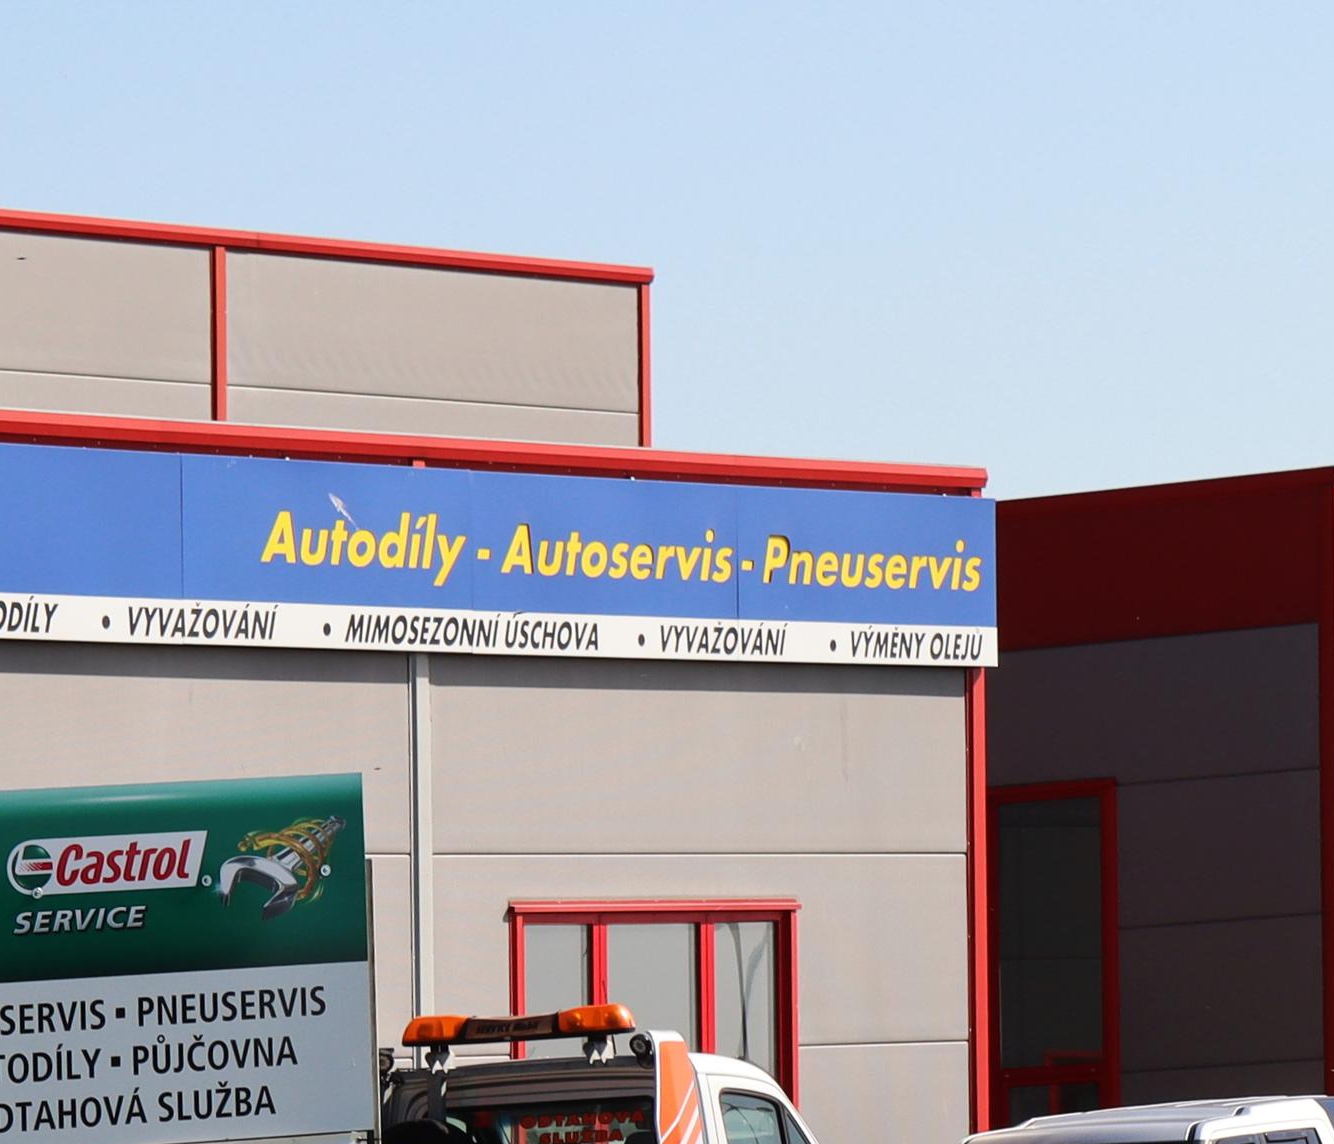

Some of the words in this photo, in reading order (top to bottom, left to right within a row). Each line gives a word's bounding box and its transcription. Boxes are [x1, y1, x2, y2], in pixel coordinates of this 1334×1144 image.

[262, 510, 467, 586] Autodíly
[501, 522, 733, 584] Autoservis
[763, 534, 982, 592] Pneuservis
[128, 602, 278, 642] VYVAŽOVÁNÍ
[345, 611, 501, 647] MIMOSEZONNÍ
[504, 614, 599, 651] ÚSCHOVA
[659, 620, 786, 656] VYVAŽOVÁNÍ
[850, 624, 924, 660] VÝMĚNY
[930, 626, 983, 661] OLEJŮ
[56, 838, 191, 888] Castrol
[14, 906, 148, 935] SERVICE
[137, 986, 327, 1028] PNEUSERVIS
[133, 1034, 299, 1076] PŮJČOVNA
[158, 1085, 276, 1124] SLUŽBA
